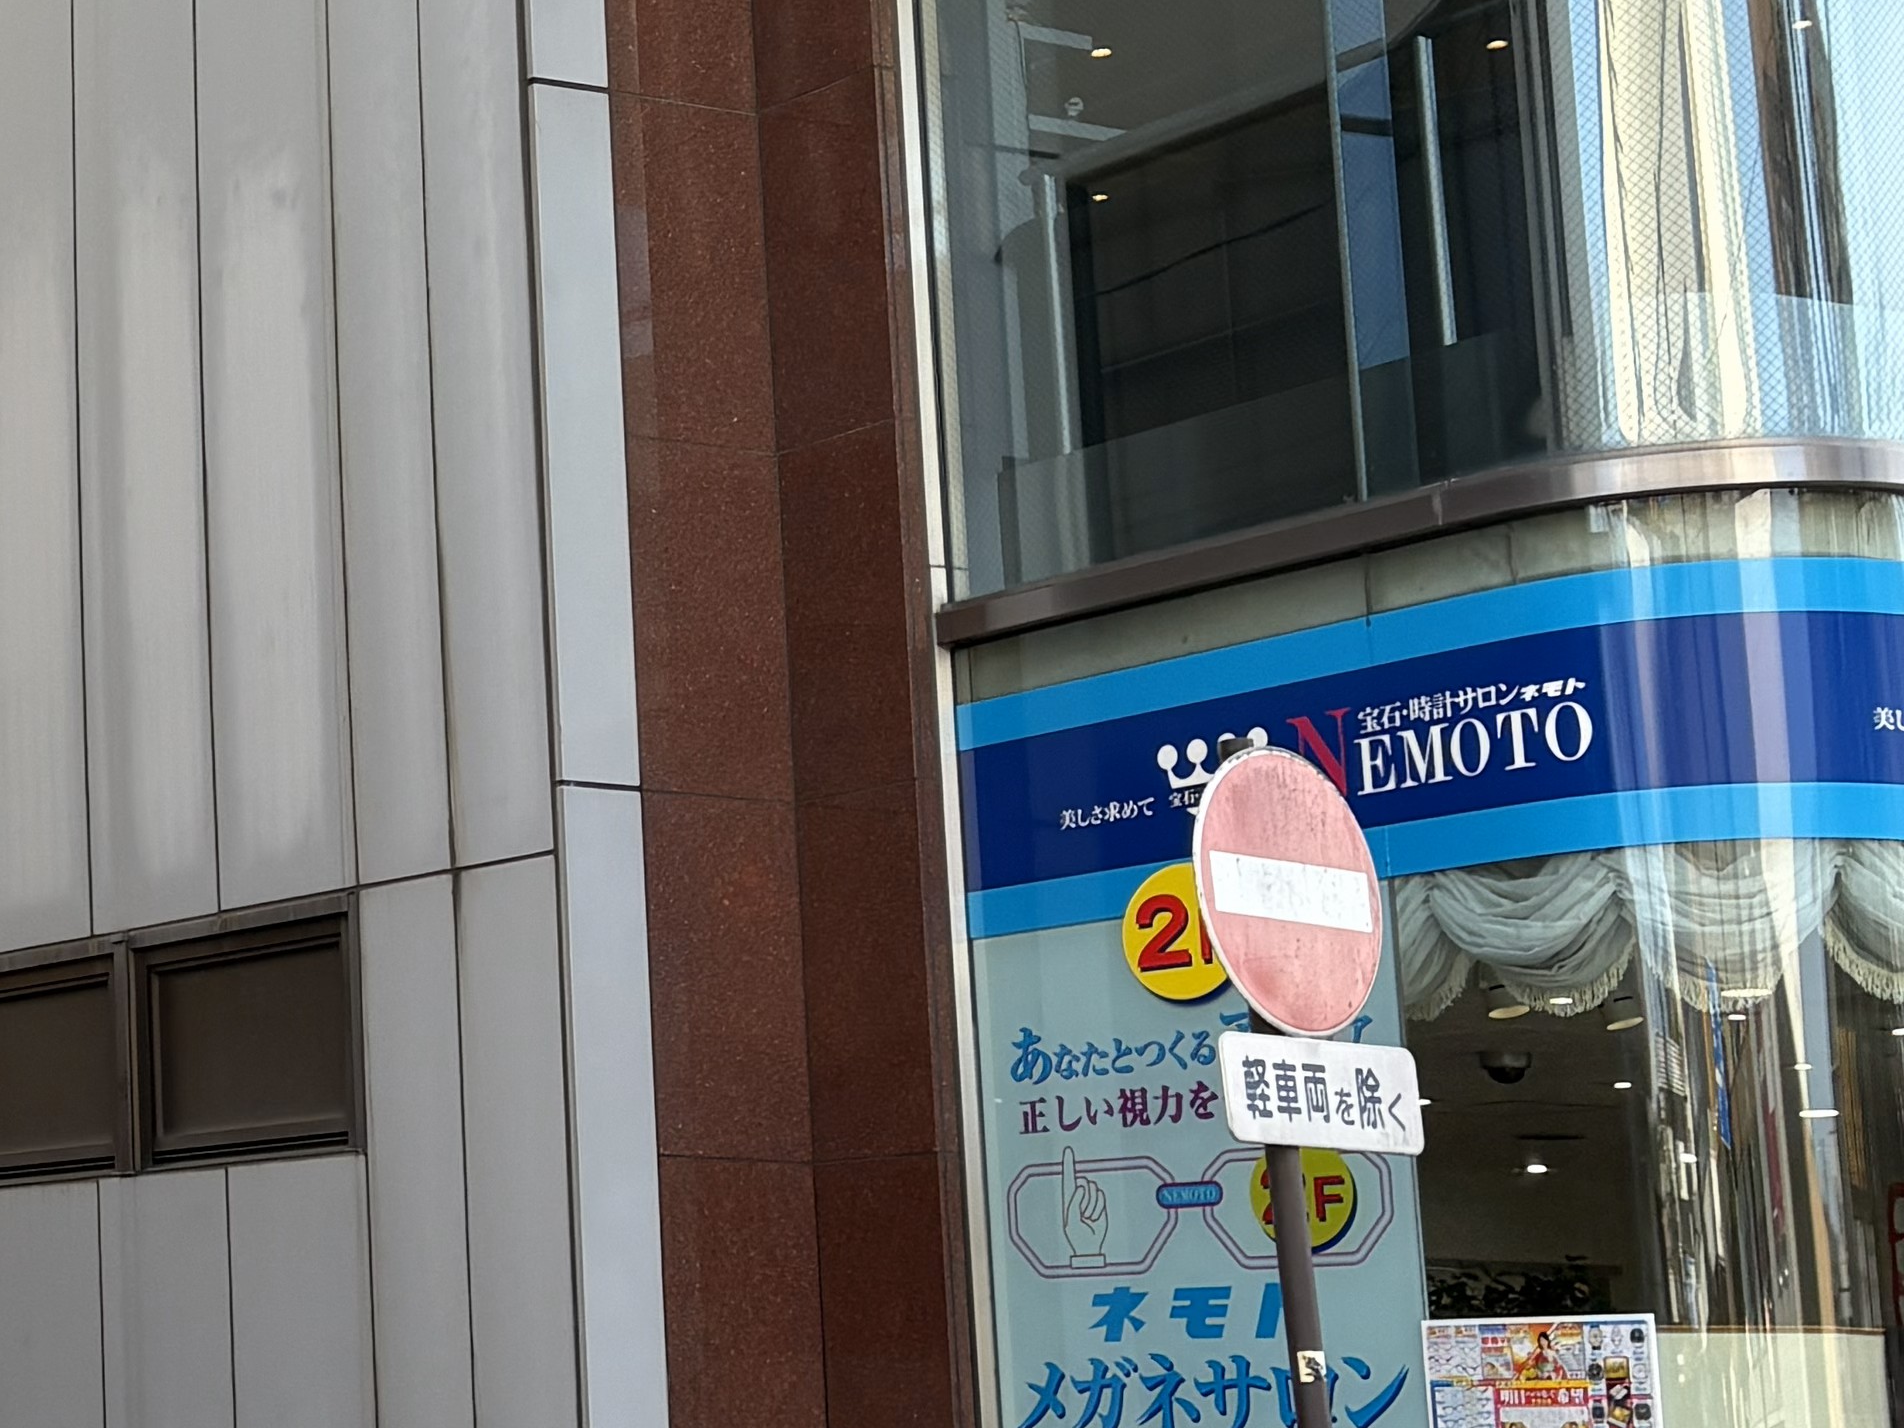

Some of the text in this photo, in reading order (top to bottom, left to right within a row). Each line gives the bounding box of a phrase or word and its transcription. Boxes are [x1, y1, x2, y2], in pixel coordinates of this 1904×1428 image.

[1285, 701, 1594, 797] NEMOTO
[1135, 894, 1213, 973] 2
[1009, 1026, 1217, 1085] あなたとつくる
[1242, 1055, 1406, 1132] 軽車両を除く
[1018, 1080, 1220, 1135] 正しい視力を
